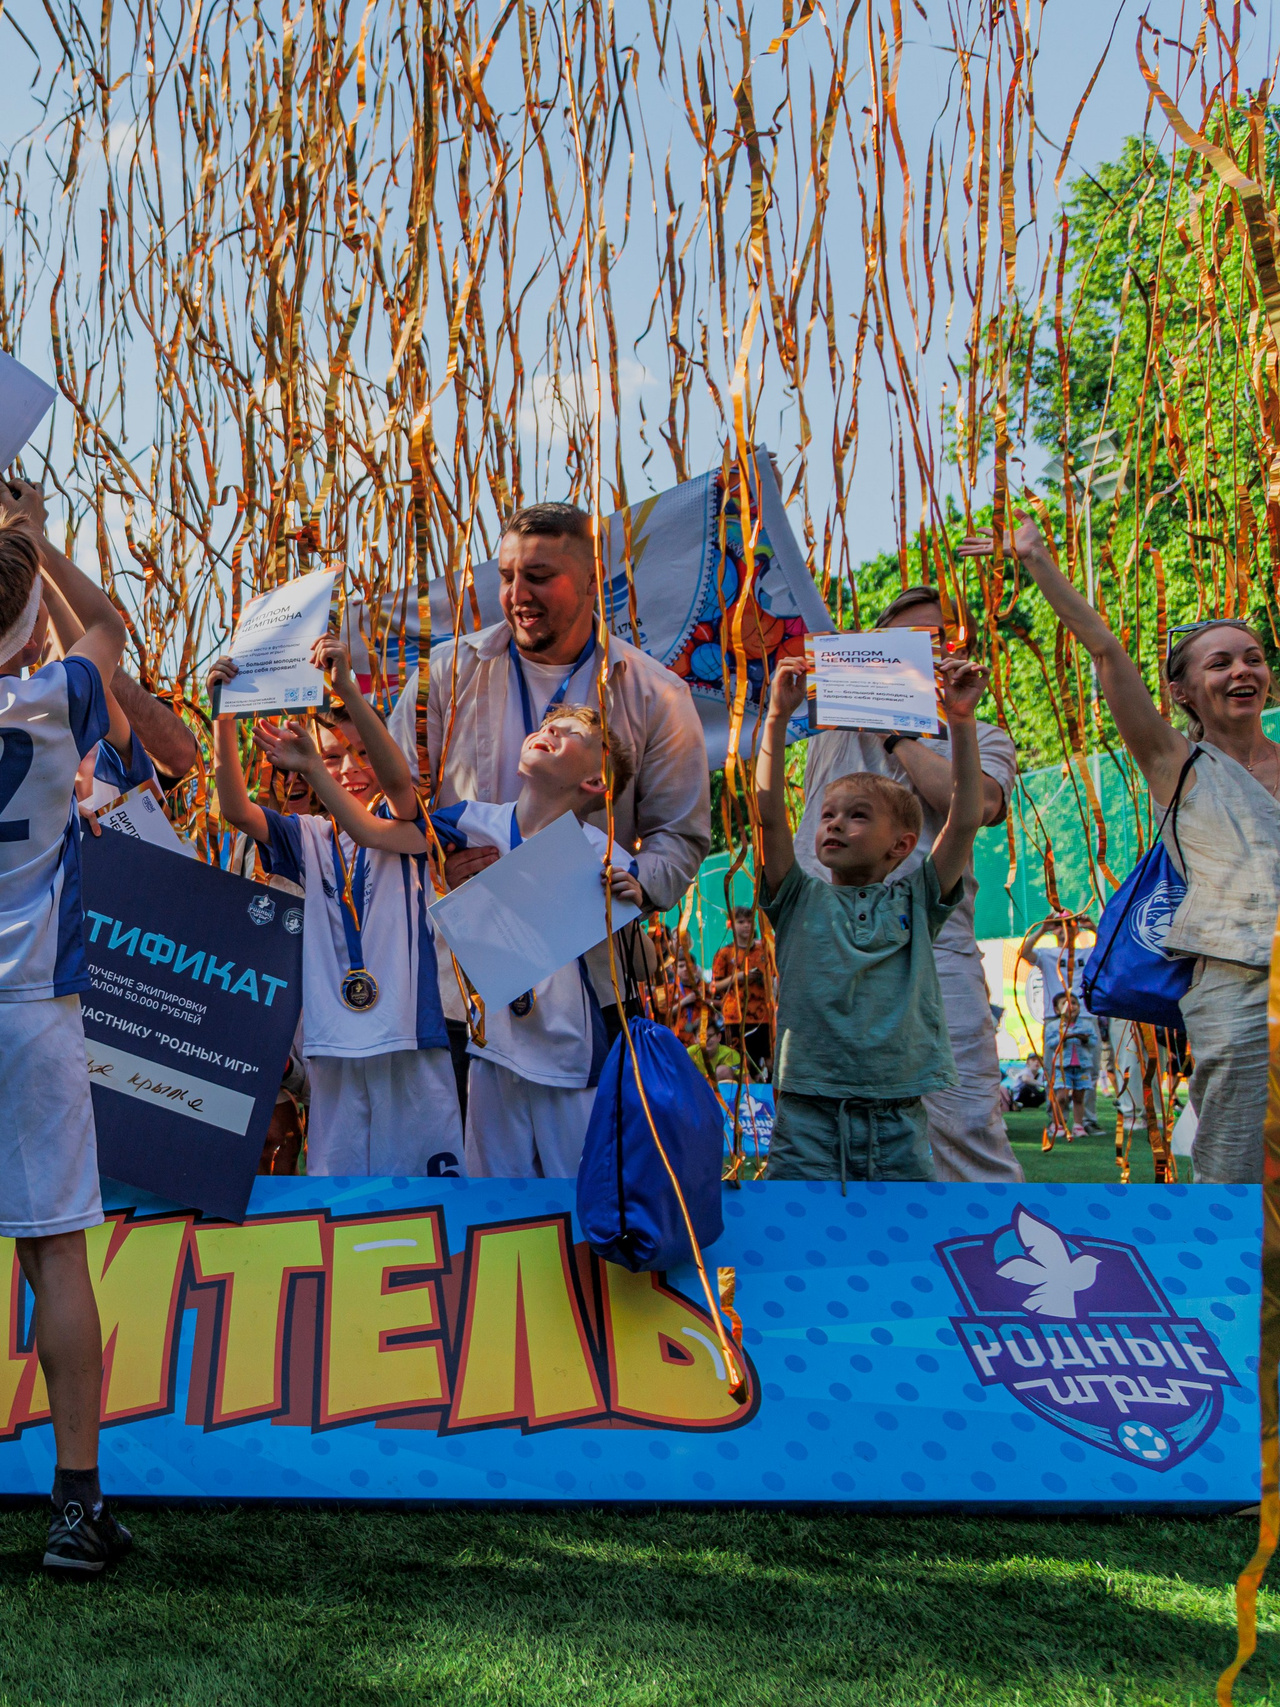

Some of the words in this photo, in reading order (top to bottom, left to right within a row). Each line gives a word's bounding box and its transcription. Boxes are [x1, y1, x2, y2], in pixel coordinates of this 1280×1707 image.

[242, 611, 302, 632] ЧЕМПИОНА
[244, 606, 291, 627] ДИПЛОМ
[82, 909, 288, 1007] ТИФИКАТ
[90, 977, 124, 998] АЛОМ
[125, 992, 159, 1010] 50.000
[161, 1004, 202, 1025] РУБЛЕЙ
[136, 981, 207, 1015] ЭКИПИРОВКИ
[155, 1032, 224, 1066] "РОДНЫХ
[224, 1056, 259, 1075] ИГР"
[959, 1323, 1229, 1378] РОДНЫЕ
